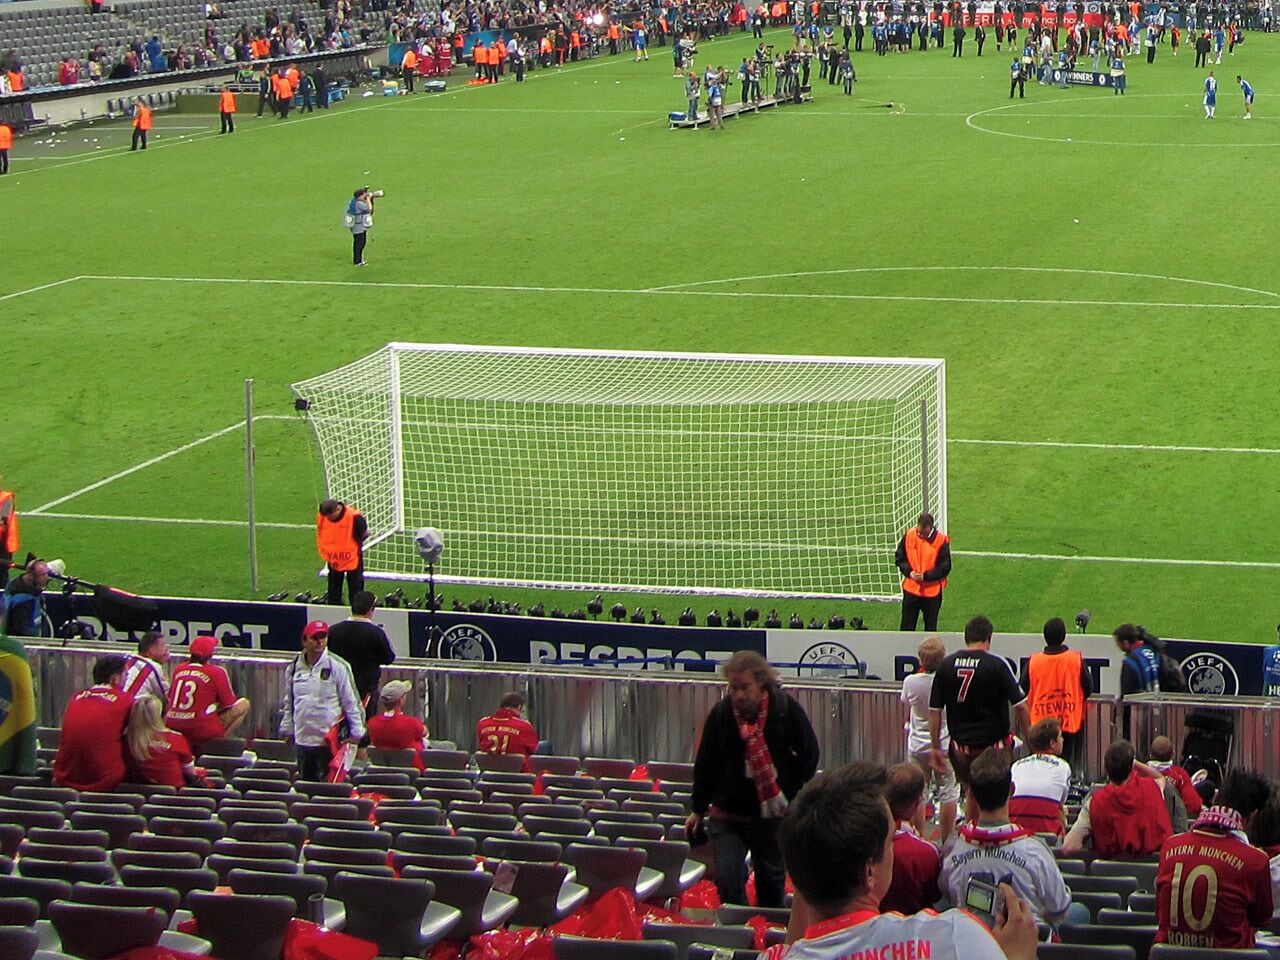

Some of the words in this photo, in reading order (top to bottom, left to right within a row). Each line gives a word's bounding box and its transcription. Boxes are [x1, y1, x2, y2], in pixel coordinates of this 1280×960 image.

[449, 627, 484, 642] UEFA
[808, 646, 847, 661] UEFA
[953, 656, 981, 668] RIBÉRY
[1186, 657, 1225, 673] UEFA
[172, 678, 198, 711] 13
[956, 668, 975, 704] 7
[1034, 701, 1076, 718] STEWARD
[952, 849, 982, 867] Bayern
[984, 847, 1027, 869] München
[1165, 844, 1195, 860] BAYERN
[1199, 845, 1244, 872] MÜNCHEN
[1170, 862, 1219, 932] 10
[1168, 930, 1214, 949] ROBBEN
